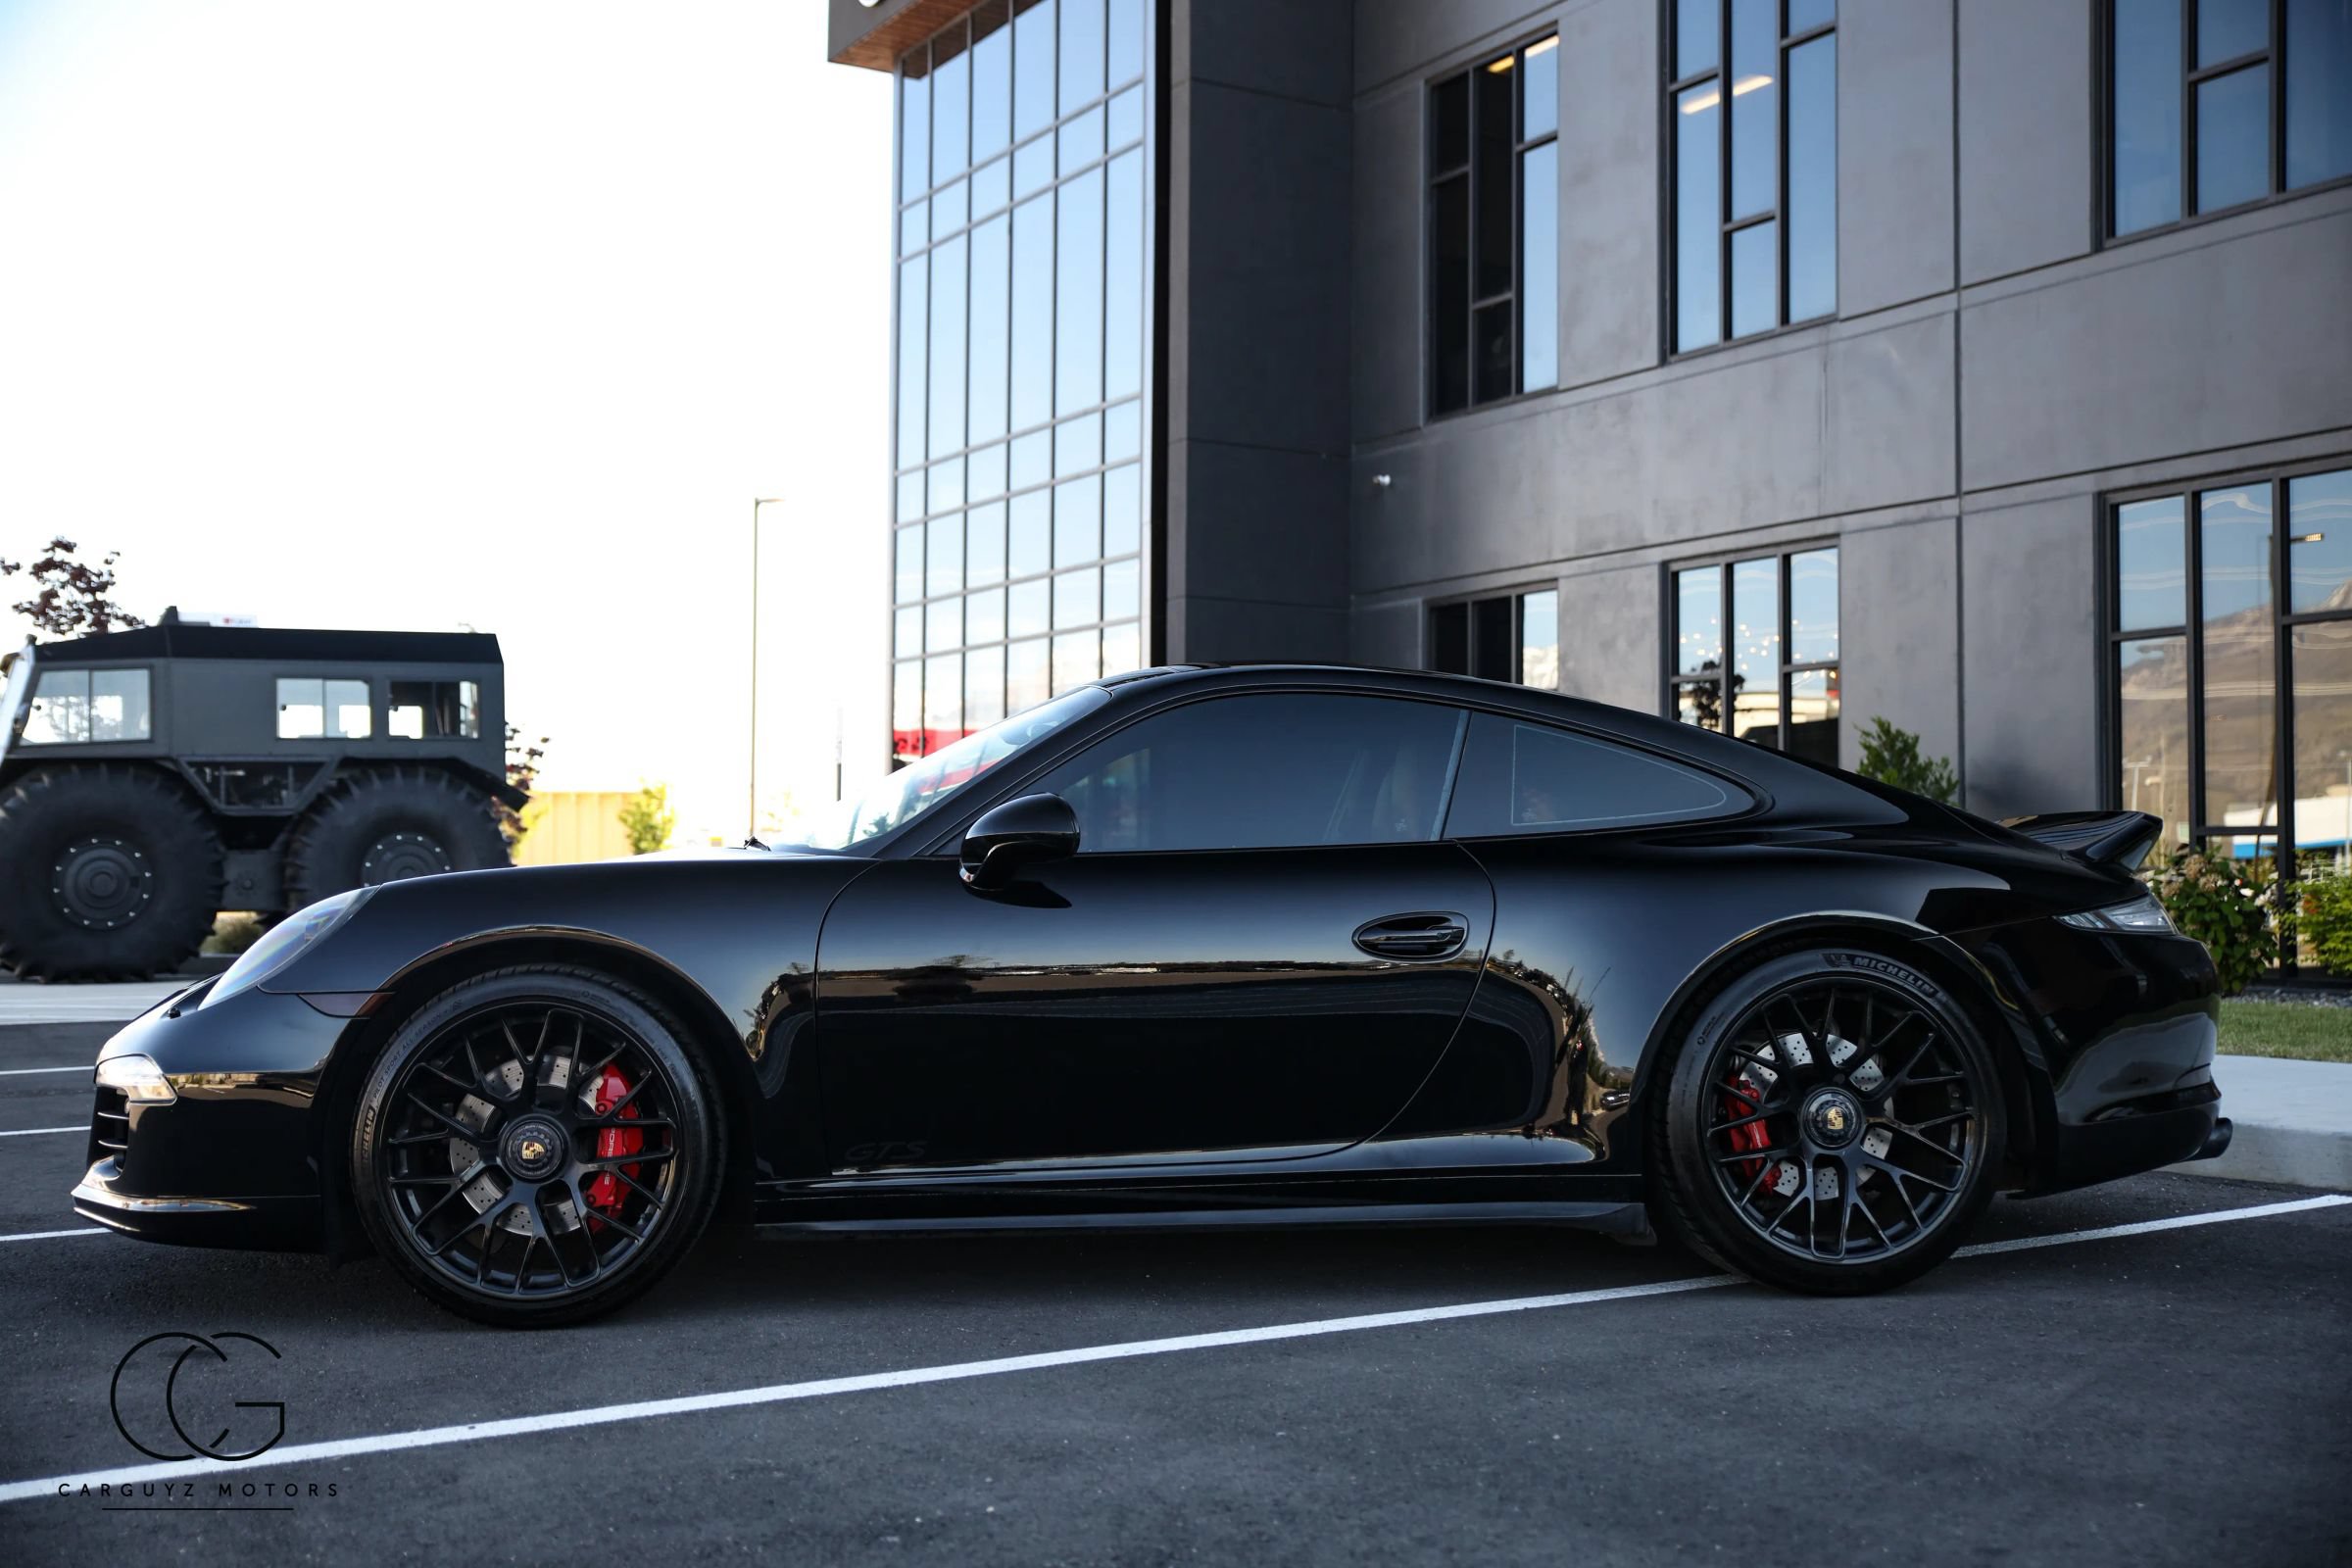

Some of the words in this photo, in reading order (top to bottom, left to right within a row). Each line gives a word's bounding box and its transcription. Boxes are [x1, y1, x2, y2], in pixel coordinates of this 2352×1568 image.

[1853, 956, 1936, 995] MICHELIN
[373, 1076, 384, 1099] PILOT
[384, 1051, 401, 1075] SPORT
[844, 1140, 928, 1161] GTS
